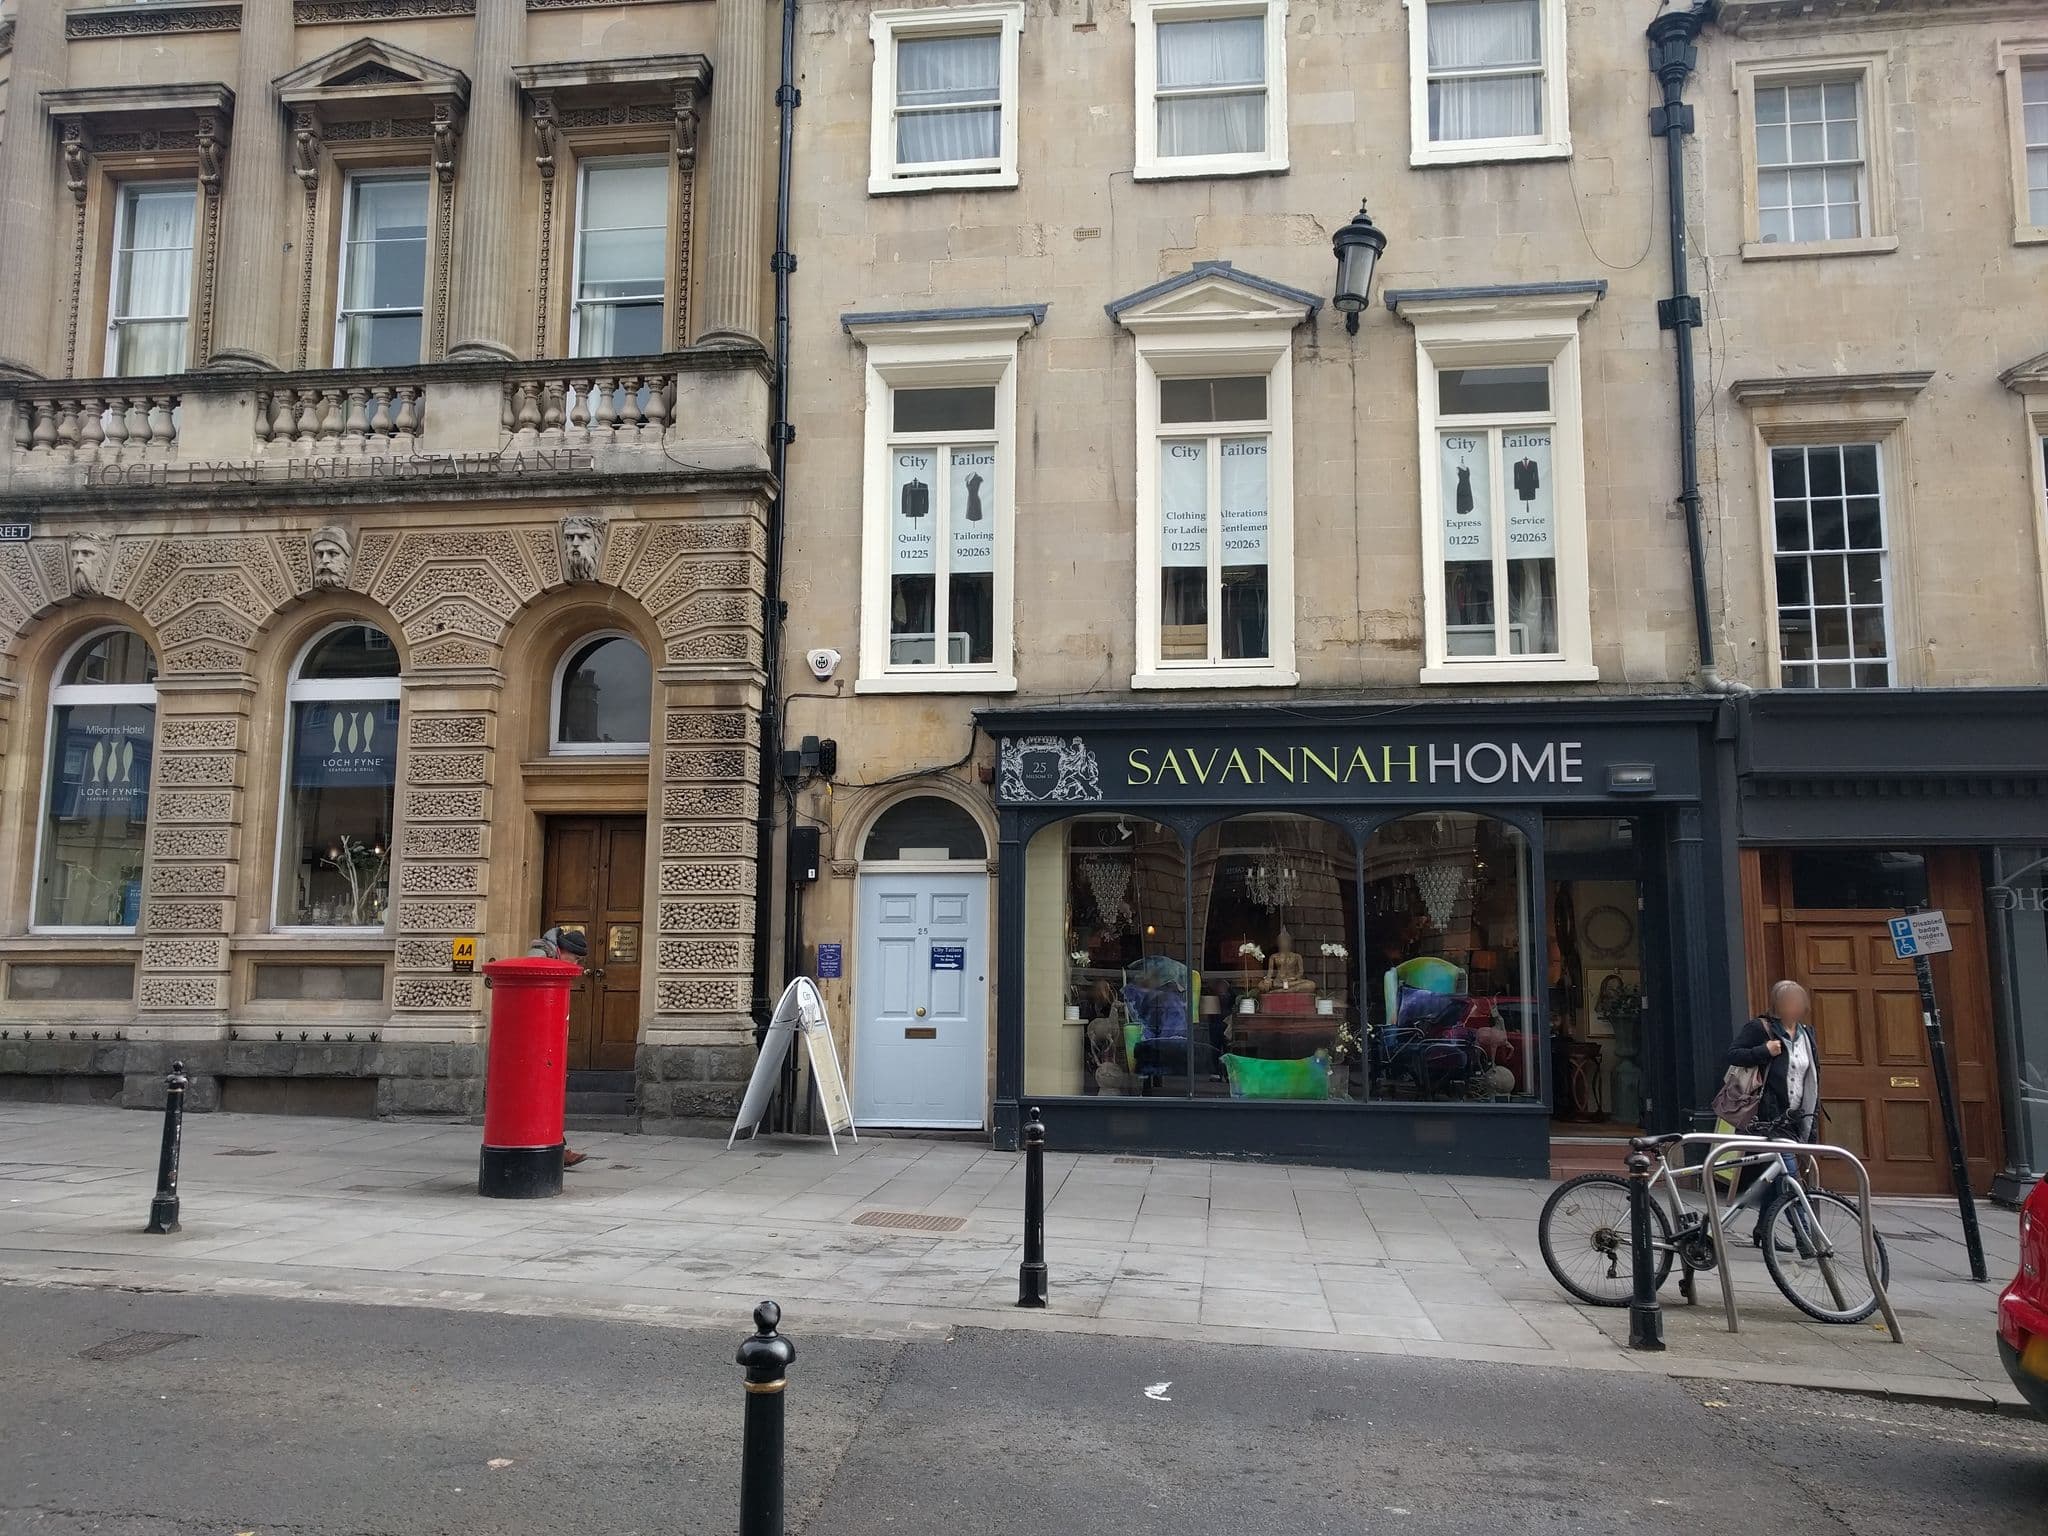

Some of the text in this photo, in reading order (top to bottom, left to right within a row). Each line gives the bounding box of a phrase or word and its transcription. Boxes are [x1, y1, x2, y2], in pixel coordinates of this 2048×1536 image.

[1446, 435, 1551, 453] City Tailors
[1171, 444, 1267, 460] City Tailors
[87, 463, 168, 485] LOCH
[288, 457, 350, 480] FISH
[371, 448, 580, 479] RESTAURANT
[900, 454, 995, 470] City Tailors
[1166, 511, 1206, 521] Clothing
[1446, 516, 1545, 529] Express Service
[1163, 526, 1177, 534] For
[898, 532, 994, 543] Quality Tailoring
[1449, 533, 1547, 545] 01225 920263
[1171, 540, 1260, 551] 01225 920263
[900, 547, 990, 559] 01225 920263
[86, 725, 145, 735] Milsoms Hotel
[322, 759, 350, 767] LOCH
[1033, 762, 1046, 773] 25
[81, 788, 108, 796] LOCH
[1913, 919, 1942, 927] Disabled
[918, 927, 928, 935] 25
[1919, 926, 1939, 934] badge
[456, 943, 472, 956] AA
